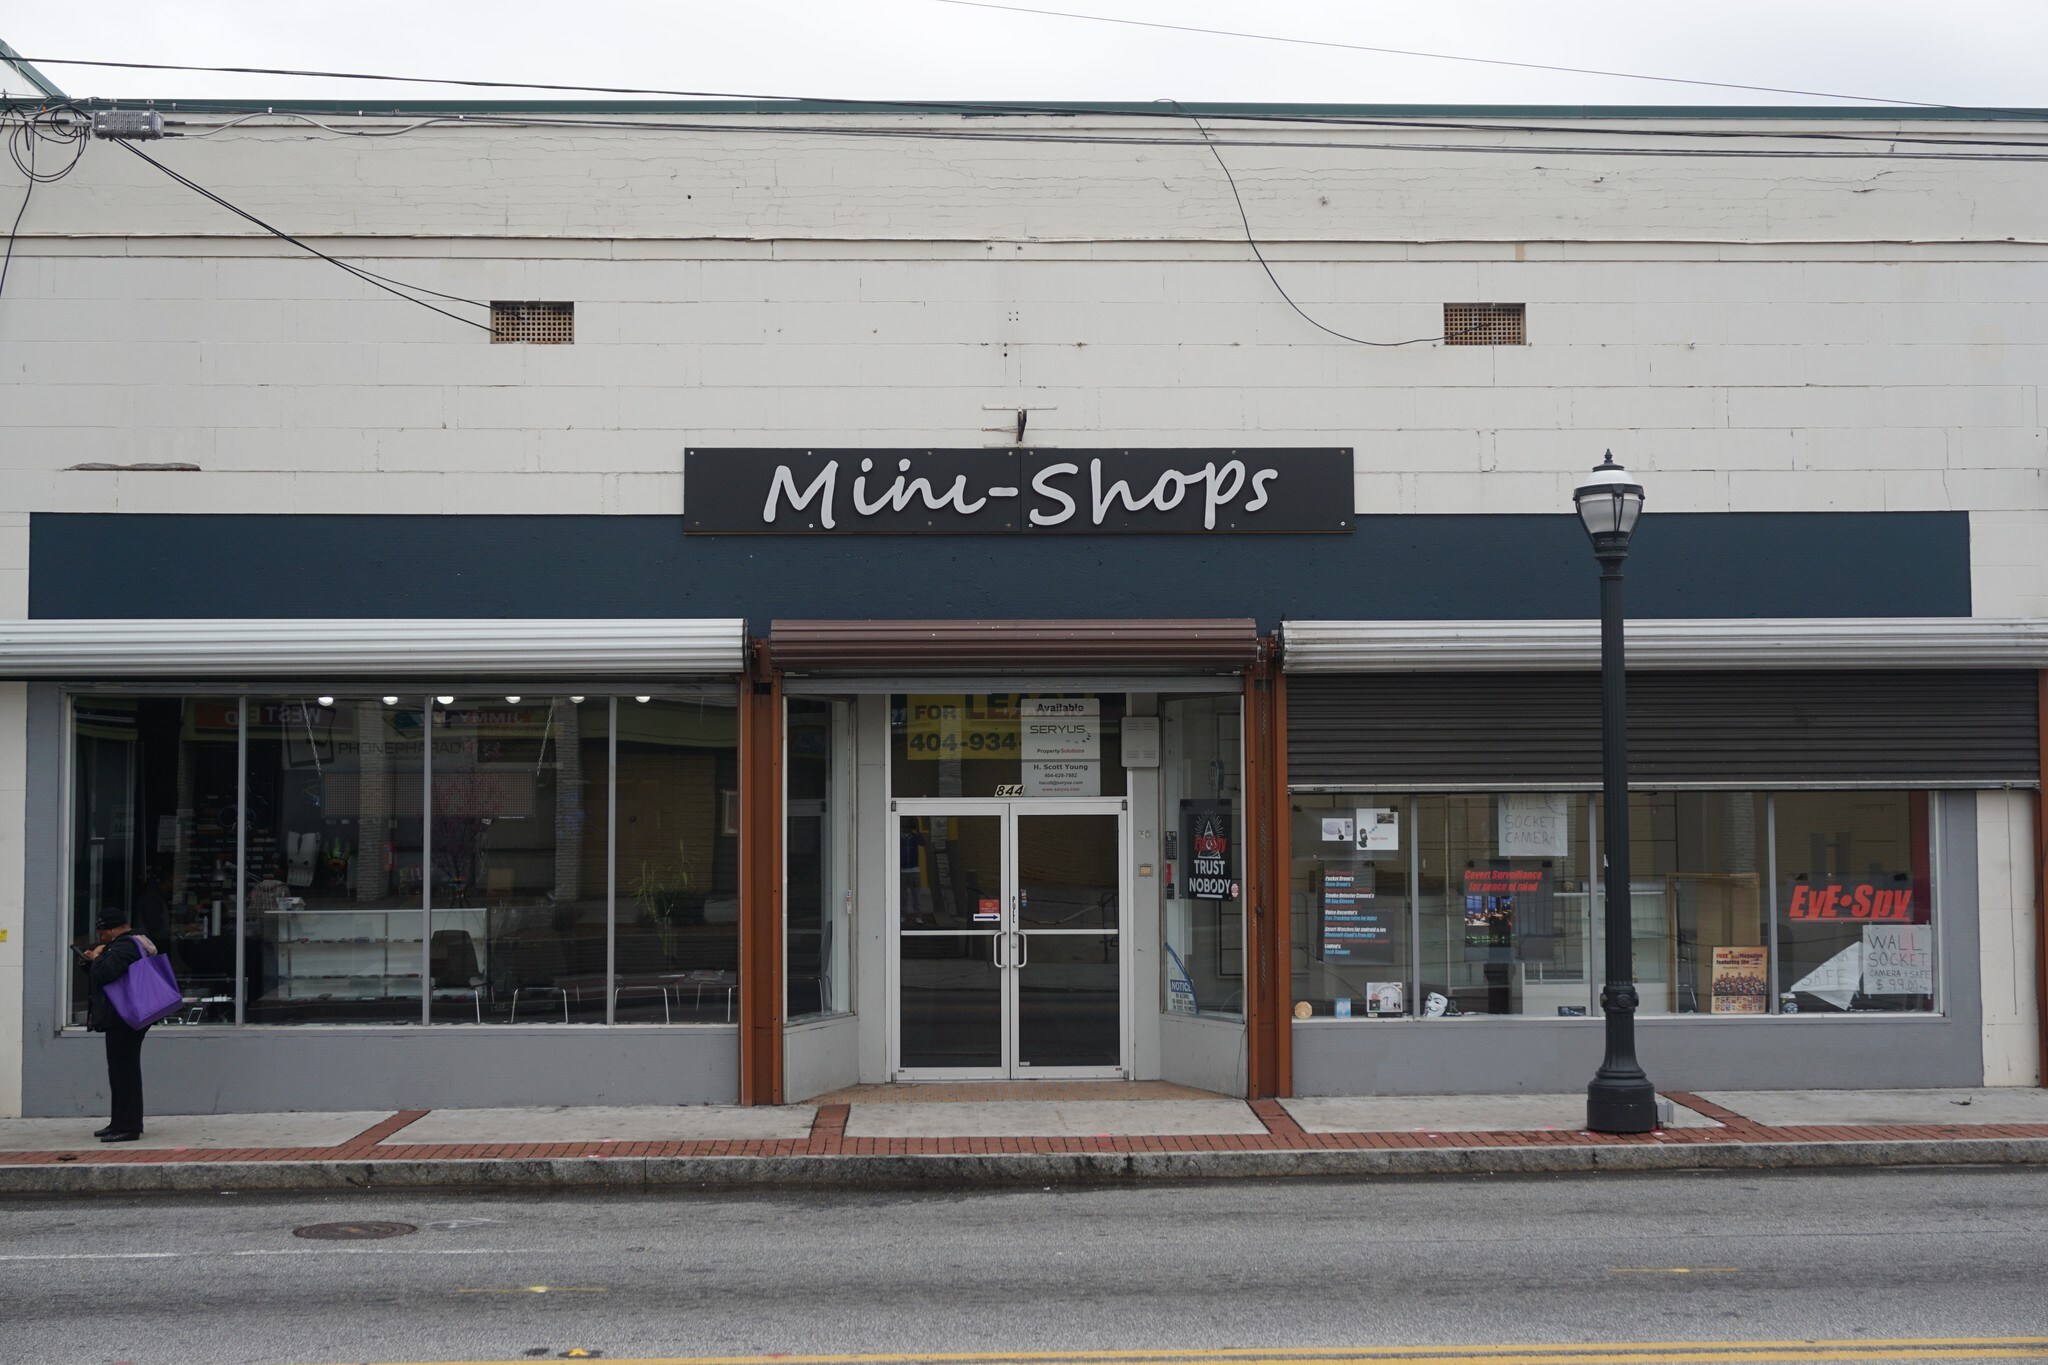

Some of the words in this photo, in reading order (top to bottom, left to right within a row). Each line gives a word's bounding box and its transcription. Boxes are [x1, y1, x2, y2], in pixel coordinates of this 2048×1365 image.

[763, 459, 1278, 530] Mini-Shops
[914, 704, 957, 720] FOR
[1037, 703, 1084, 712] Available
[1030, 725, 1085, 734] SERYUS
[910, 733, 1021, 752] 404-934
[996, 786, 1023, 797] 844
[1502, 793, 1547, 810] WALL
[1504, 814, 1558, 829] SOCKET
[1505, 832, 1556, 845] CAMERA
[1194, 860, 1225, 875] TRUST
[1465, 870, 1491, 880] Covert
[1492, 870, 1543, 880] Surveillance
[1189, 877, 1231, 894] NOBODY
[1518, 882, 1539, 891] mind
[1867, 933, 1923, 951] WALL
[1867, 952, 1928, 968] SOCKET
[1869, 970, 1901, 978] CAMERA
